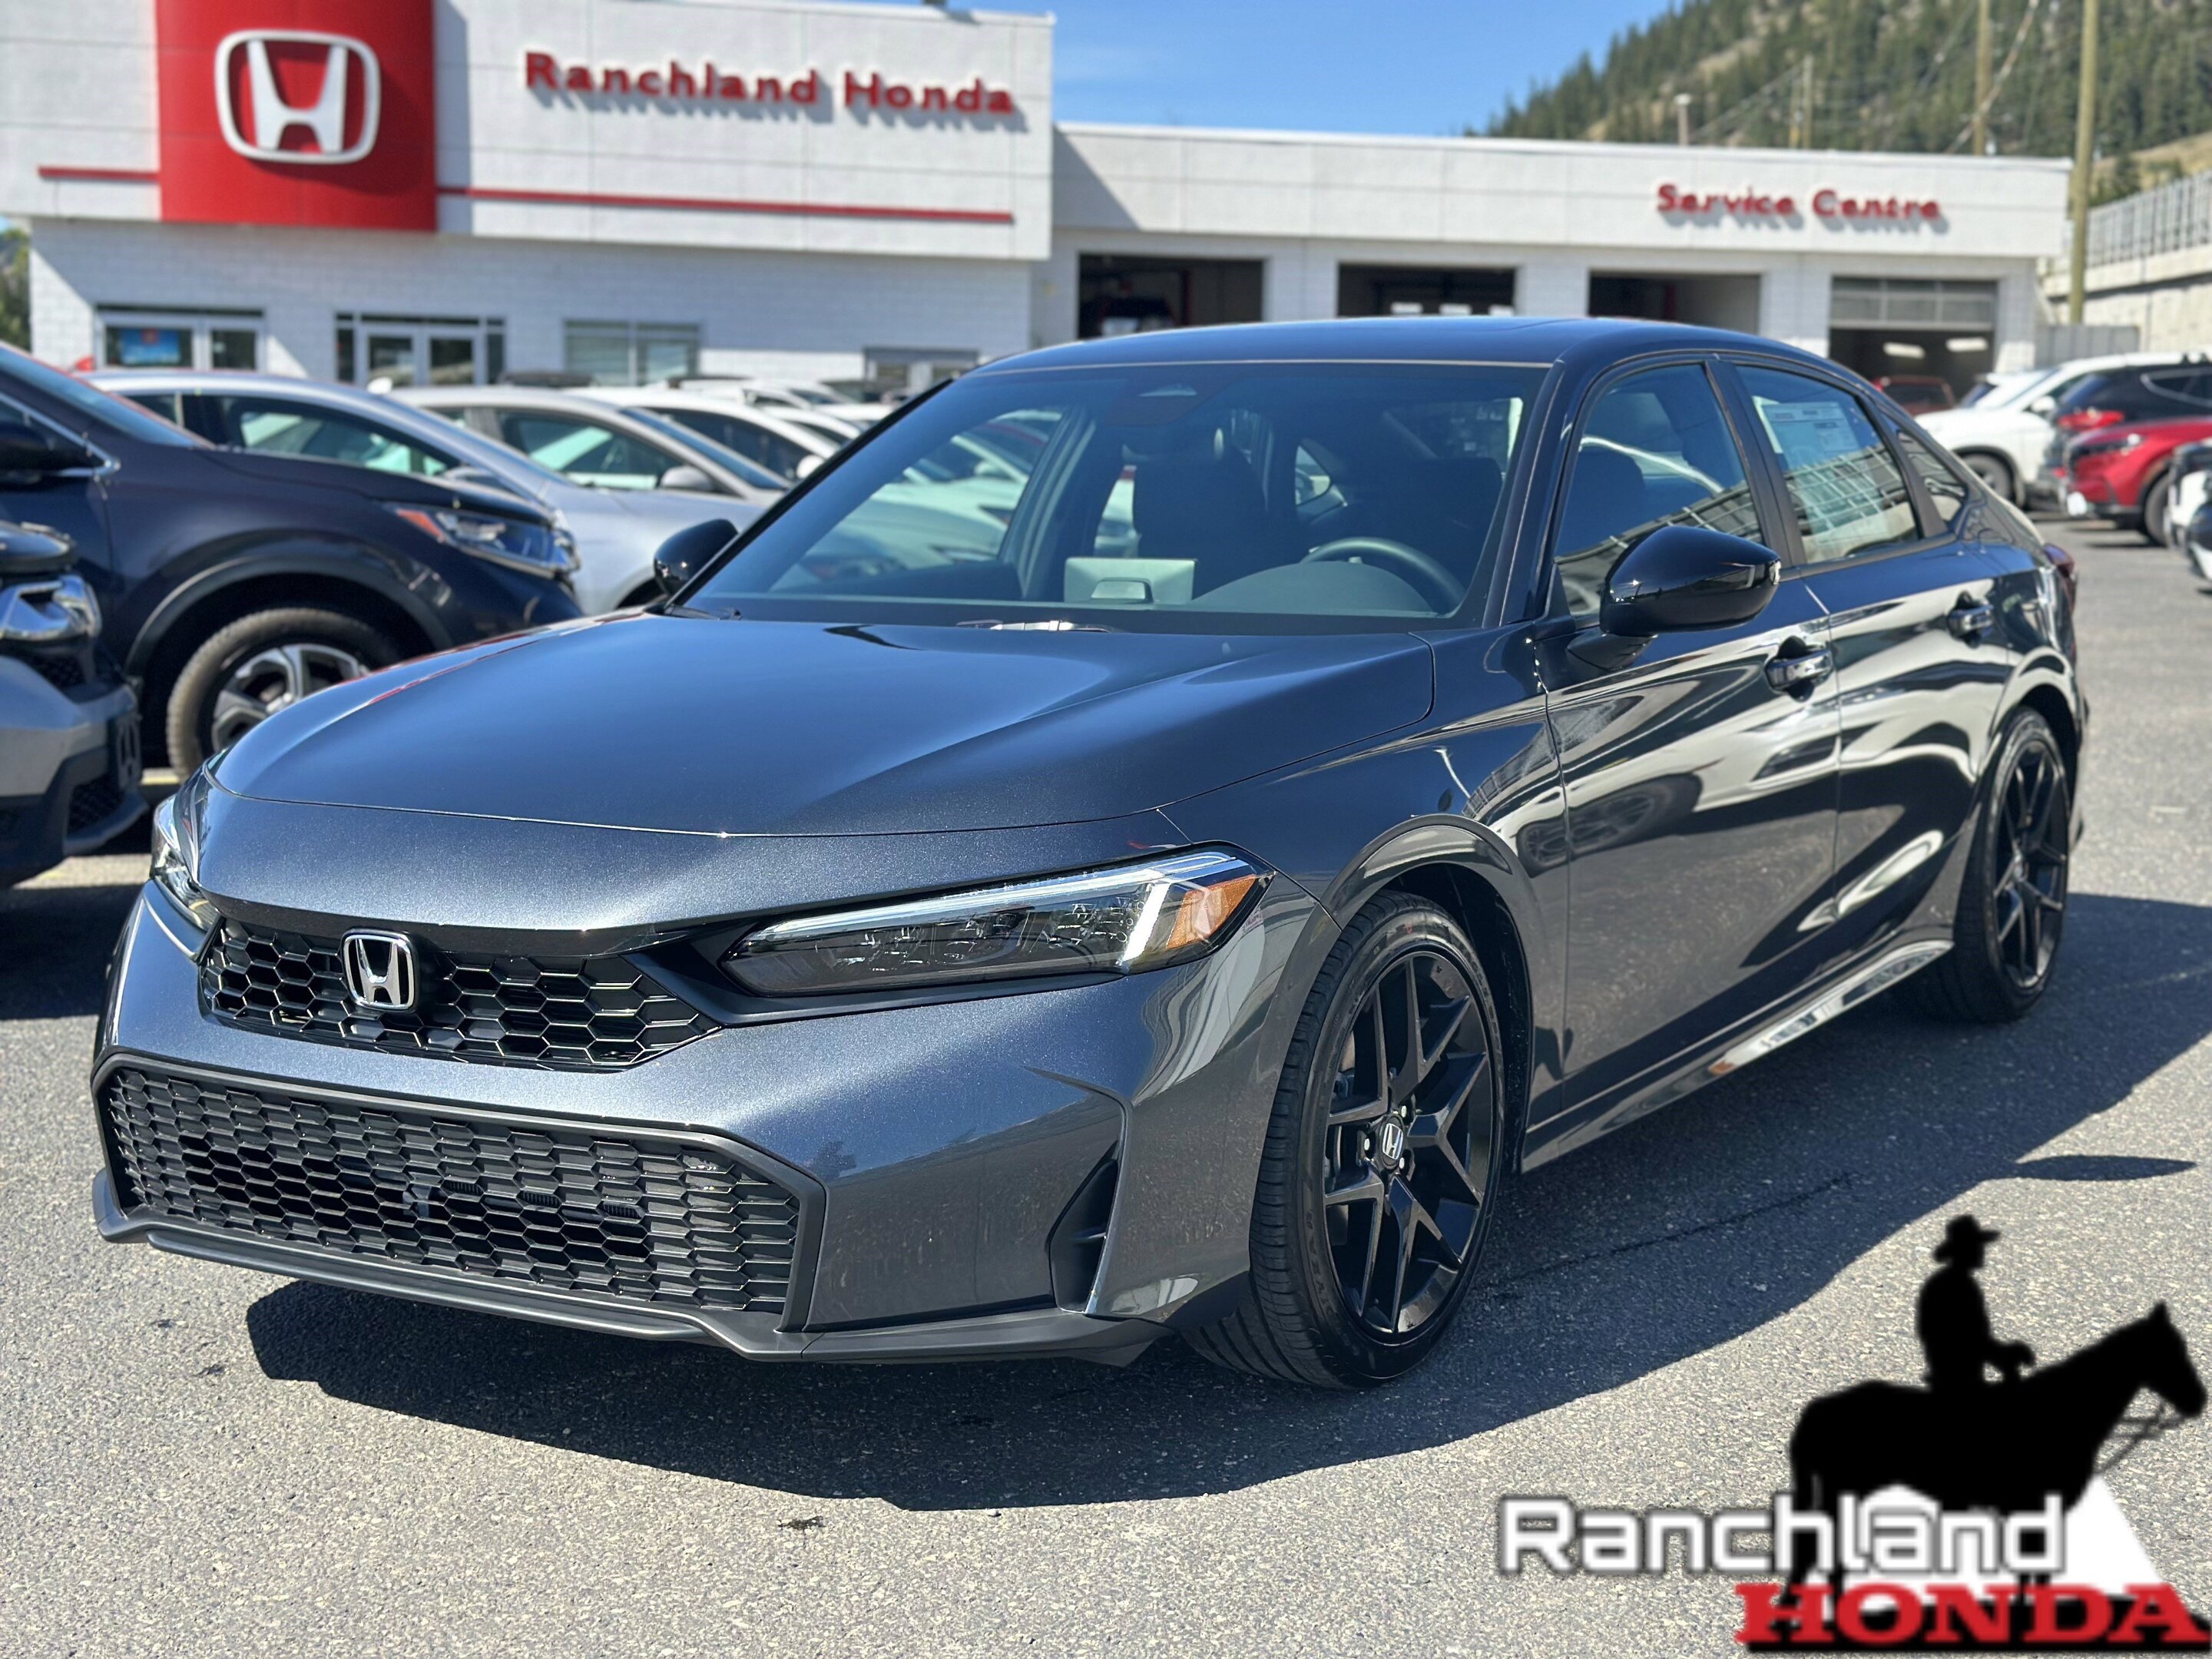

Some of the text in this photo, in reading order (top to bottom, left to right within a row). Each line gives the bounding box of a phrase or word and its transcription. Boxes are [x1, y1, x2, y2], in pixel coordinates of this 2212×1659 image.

[525, 51, 1013, 114] Ranchland Honda
[1657, 184, 1940, 219] Service Centre
